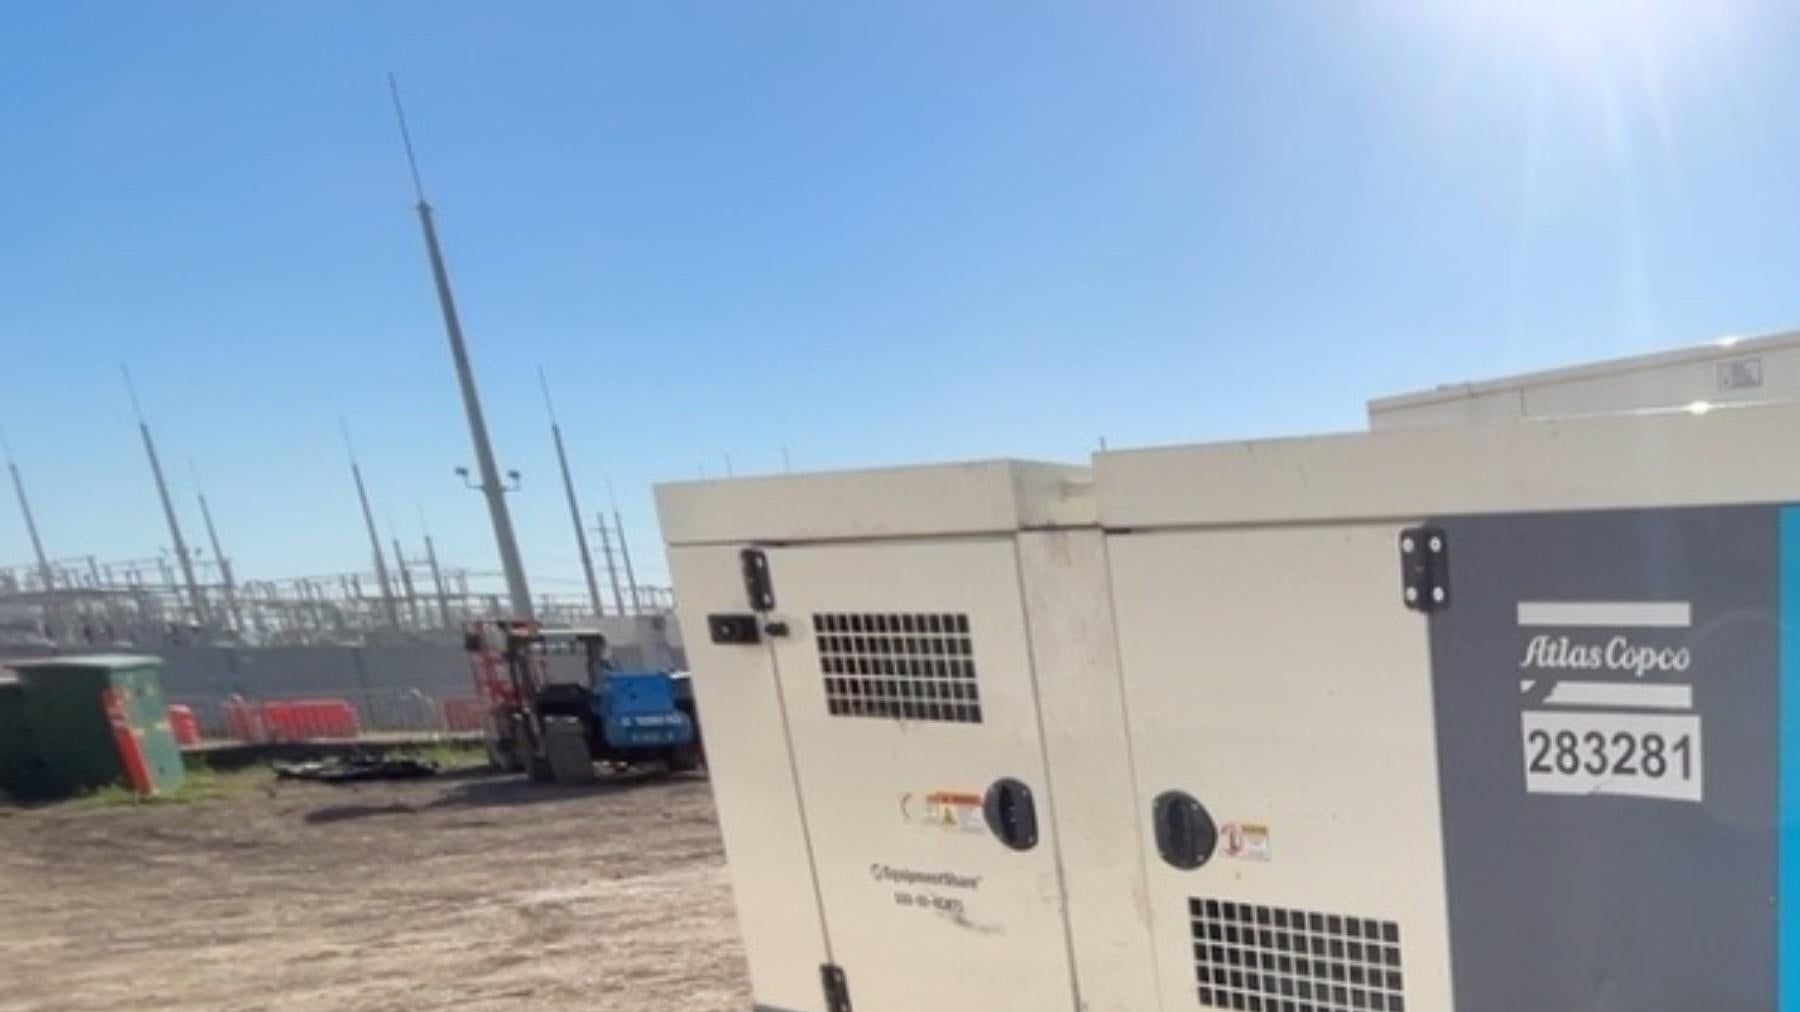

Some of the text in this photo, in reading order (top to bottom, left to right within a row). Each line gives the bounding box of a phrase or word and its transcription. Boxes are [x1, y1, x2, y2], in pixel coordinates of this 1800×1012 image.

[1520, 634, 1691, 678] Atlas Copco
[1528, 730, 1690, 781] 283281
